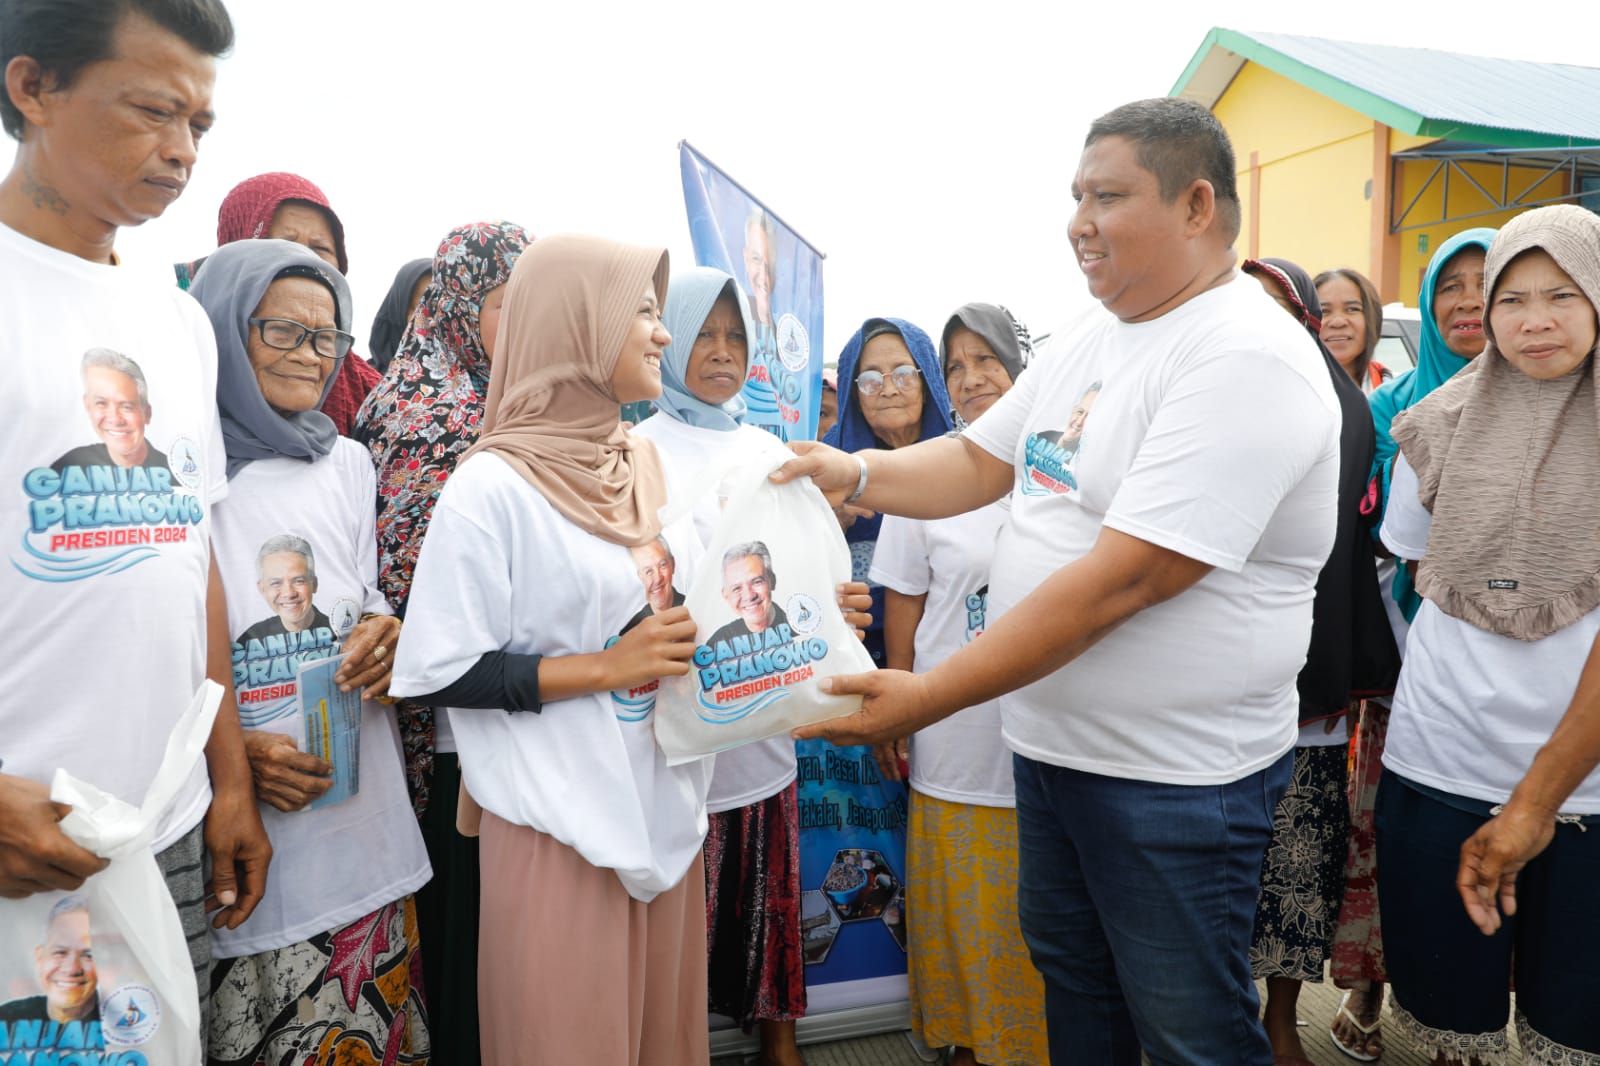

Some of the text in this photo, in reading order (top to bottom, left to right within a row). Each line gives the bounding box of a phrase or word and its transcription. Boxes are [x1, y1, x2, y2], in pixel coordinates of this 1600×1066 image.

[22, 465, 174, 499] GANJAR
[30, 494, 203, 533] PRANOWO
[50, 527, 187, 552] PRESIDEN 2024
[693, 623, 794, 669] GANJAR
[699, 637, 828, 693] PRANOWO
[240, 683, 297, 704] PRESID
[715, 665, 814, 703] PRESIDEN 2024
[826, 749, 860, 785] Pasar
